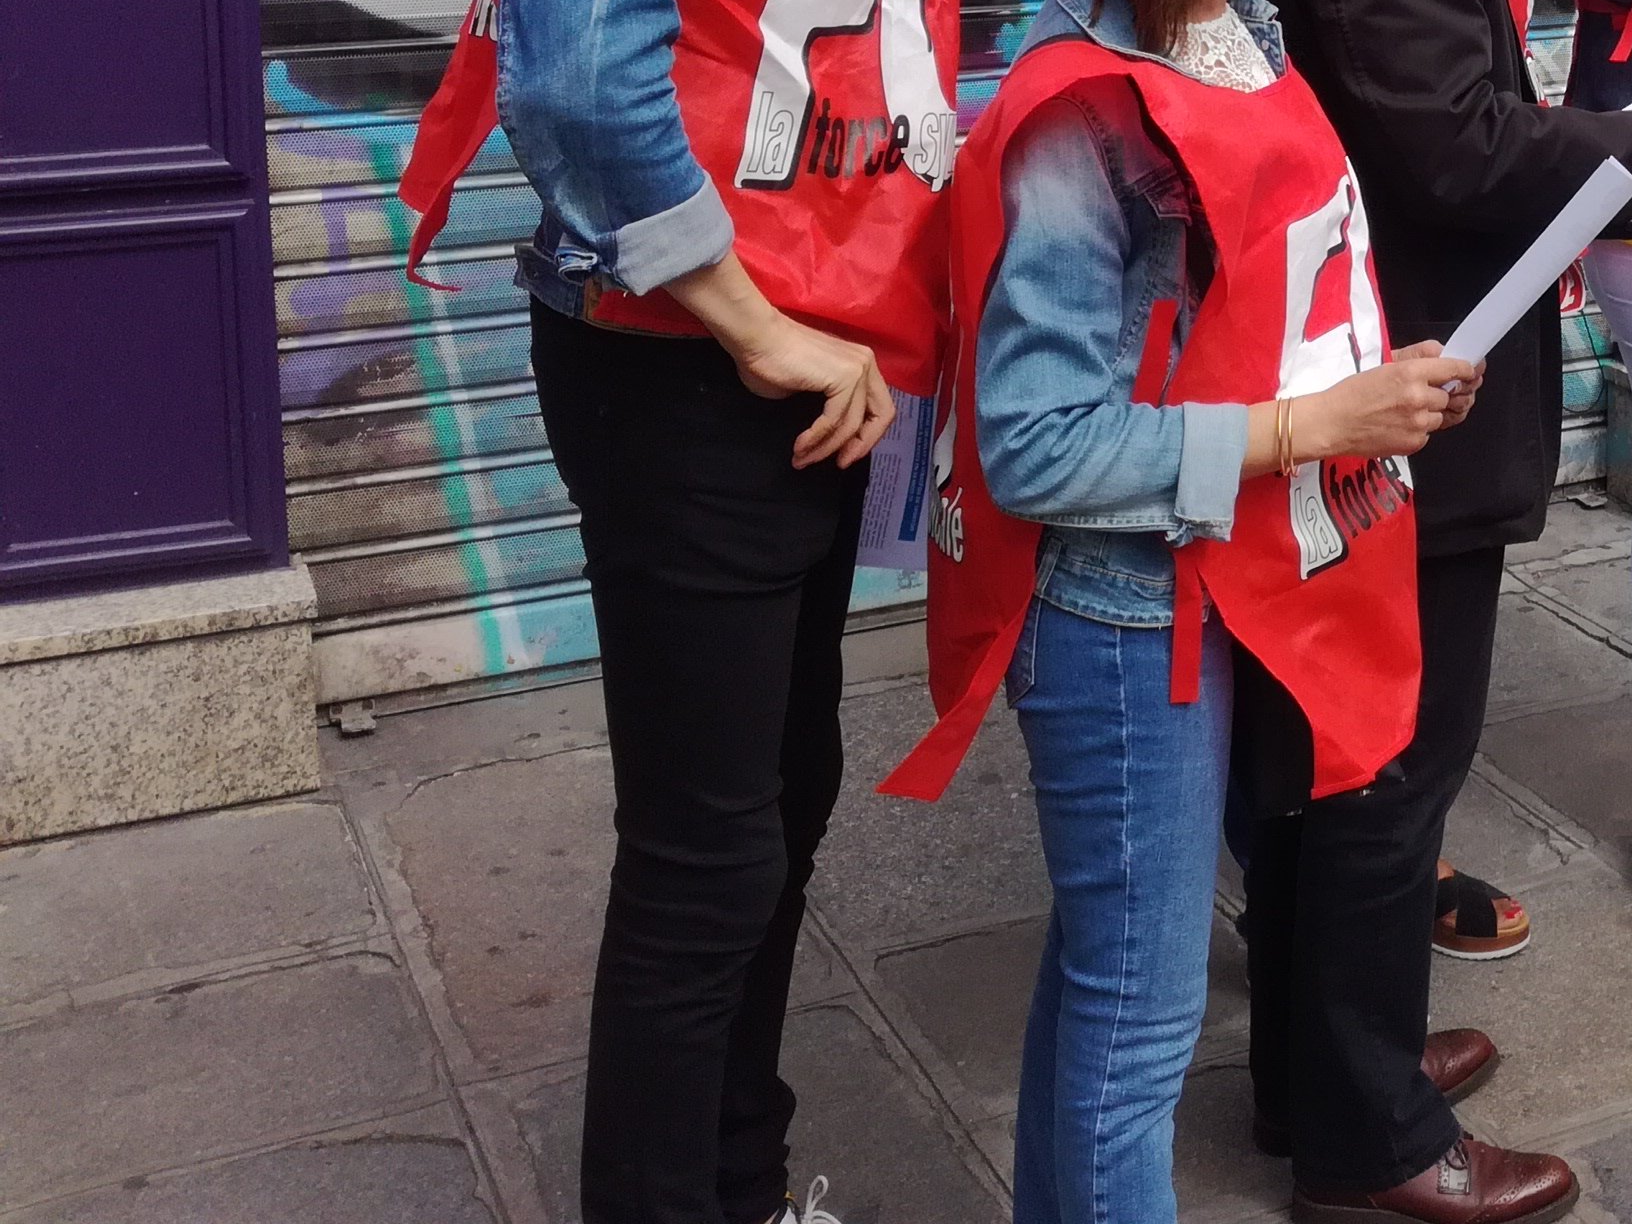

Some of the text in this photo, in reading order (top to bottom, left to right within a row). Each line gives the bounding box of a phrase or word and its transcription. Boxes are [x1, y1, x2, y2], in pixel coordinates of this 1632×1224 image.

[746, 91, 795, 175] la
[805, 97, 911, 180] force
[1329, 456, 1410, 539] force
